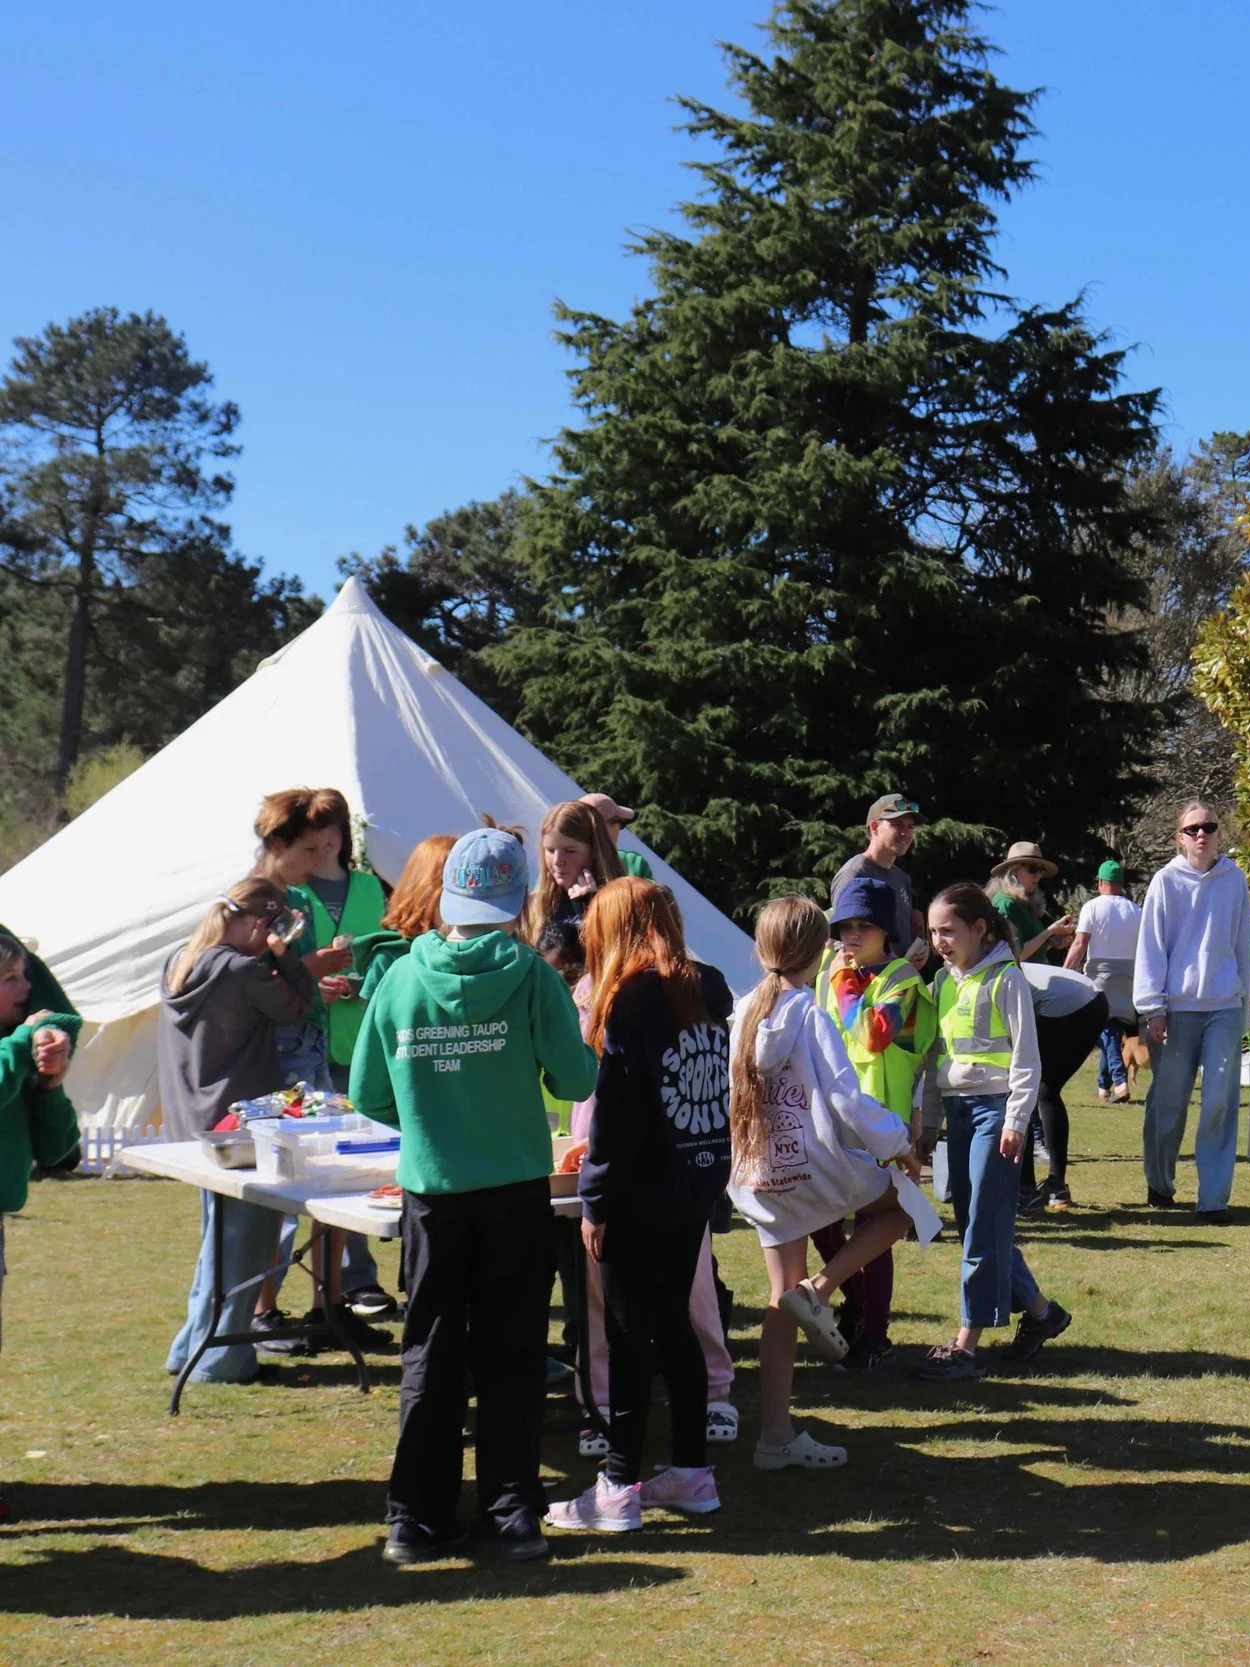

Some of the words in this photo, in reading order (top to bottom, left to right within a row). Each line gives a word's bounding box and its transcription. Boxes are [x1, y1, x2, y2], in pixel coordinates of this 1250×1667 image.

[416, 1025, 470, 1040] GREENING
[471, 1020, 508, 1037] TAUPŌ
[395, 1043, 439, 1060] STUDENT
[440, 1038, 506, 1056] LEADERSHIP
[433, 1059, 461, 1072] TEAM
[678, 1053, 729, 1103] SPORTS
[774, 1140, 800, 1157] NYC
[770, 1173, 813, 1187] Statewide
